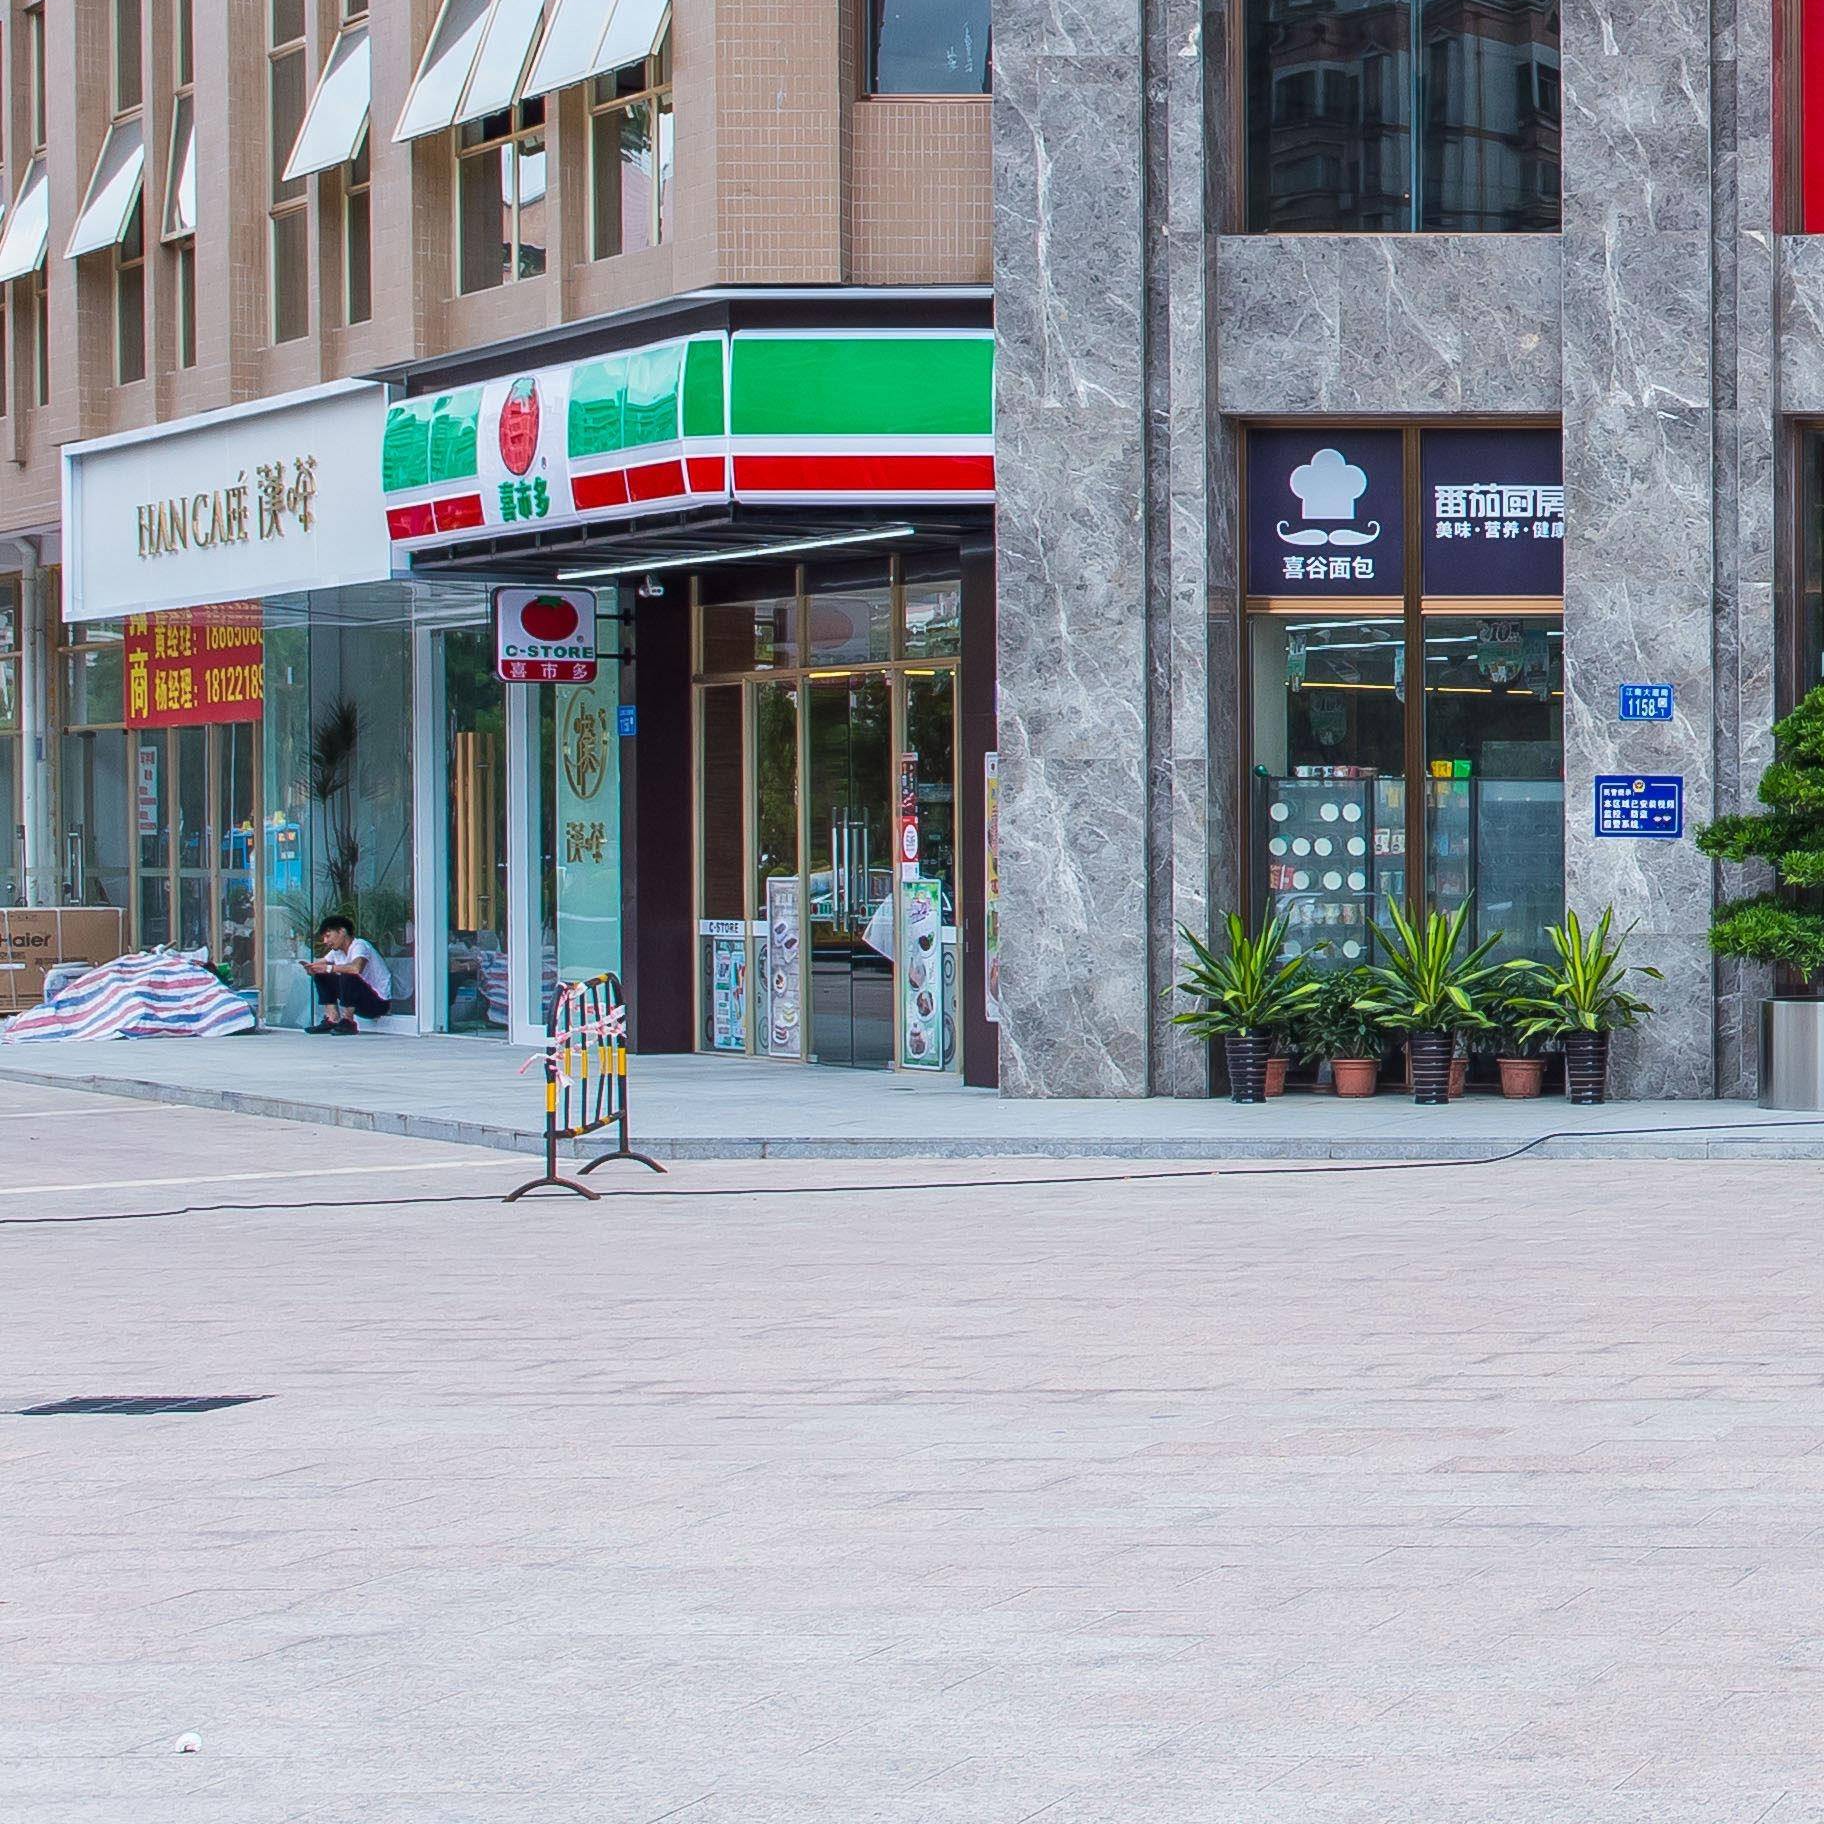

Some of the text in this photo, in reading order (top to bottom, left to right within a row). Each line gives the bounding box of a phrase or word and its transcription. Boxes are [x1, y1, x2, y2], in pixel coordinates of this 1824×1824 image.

[498, 476, 550, 523] 喜市多
[136, 496, 189, 559] HAN
[1282, 555, 1375, 580] 喜谷面包
[505, 645, 594, 659] C-STORE
[510, 662, 588, 679] 喜市多
[708, 921, 740, 934] C-STORE
